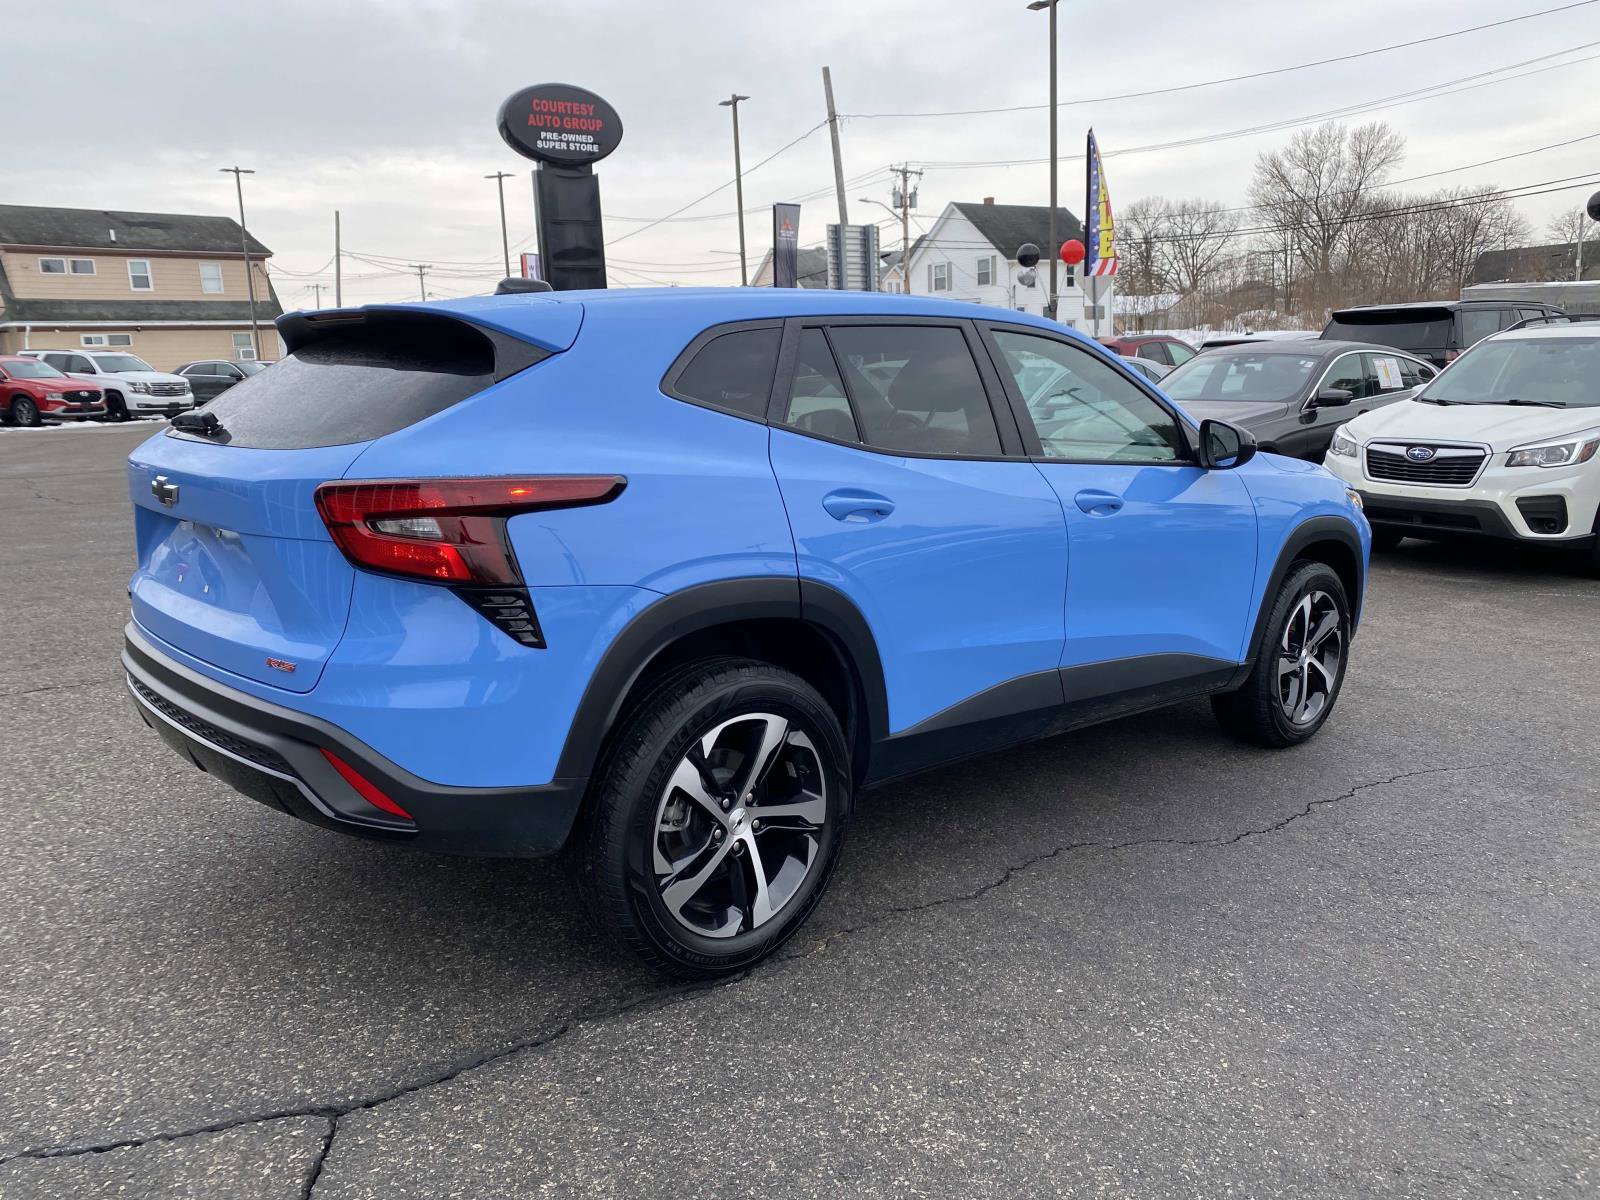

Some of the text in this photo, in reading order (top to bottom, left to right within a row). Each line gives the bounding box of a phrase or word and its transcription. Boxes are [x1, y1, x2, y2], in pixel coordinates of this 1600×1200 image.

[532, 98, 594, 116] COURTESY
[527, 113, 603, 131] AUTO GROUP
[540, 131, 594, 143] PRE-OWNED
[536, 140, 599, 152] SUPER STORE
[265, 656, 297, 673] RS
